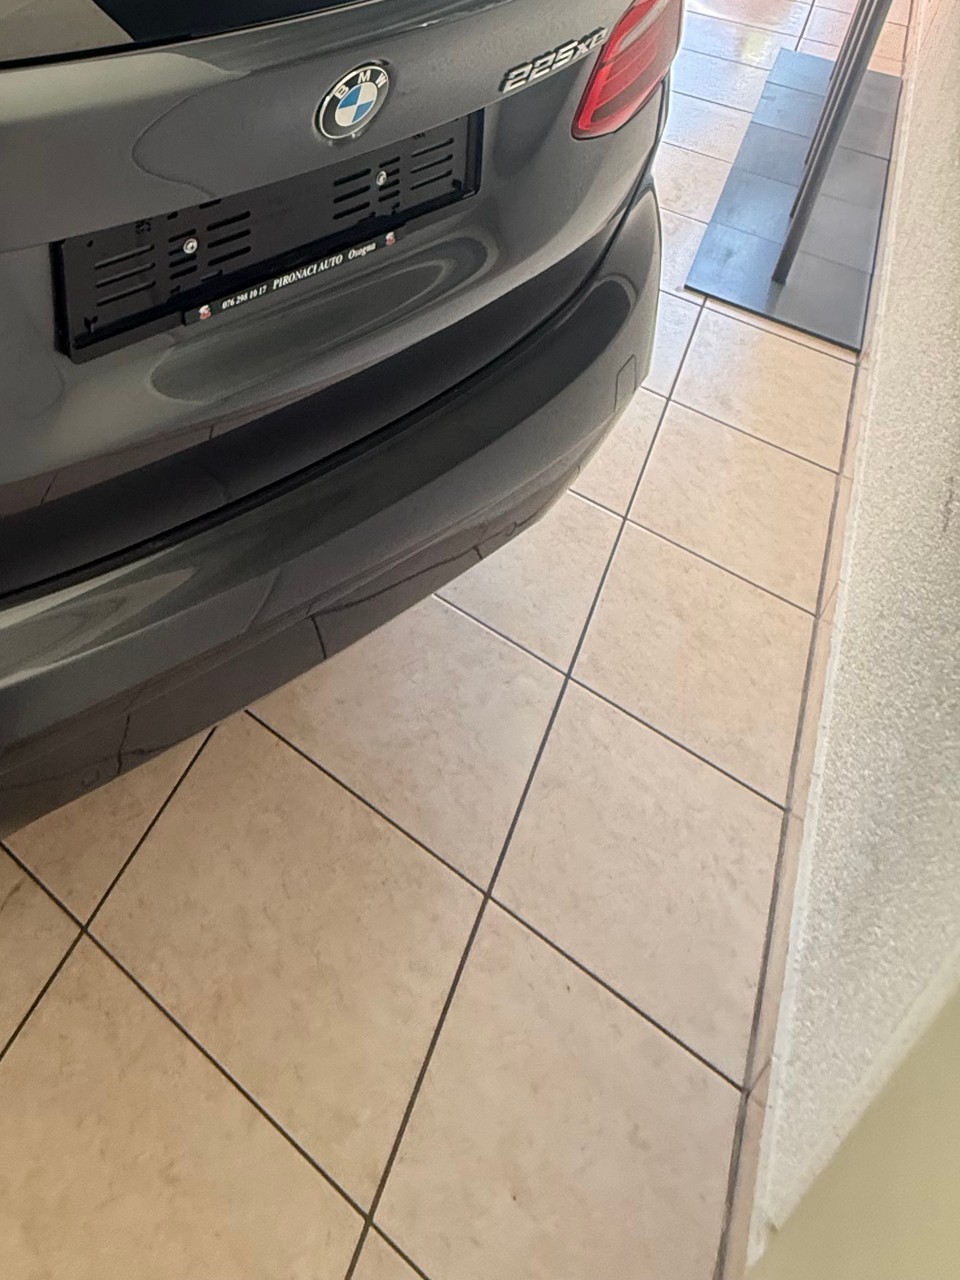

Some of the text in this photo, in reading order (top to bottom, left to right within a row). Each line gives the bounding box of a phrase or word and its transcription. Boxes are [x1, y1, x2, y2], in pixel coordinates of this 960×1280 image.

[499, 26, 608, 93] 225xe
[333, 69, 388, 100] BMW
[272, 263, 318, 290] PIRONACI
[318, 253, 344, 272] AUTO
[347, 242, 377, 260] Osogna
